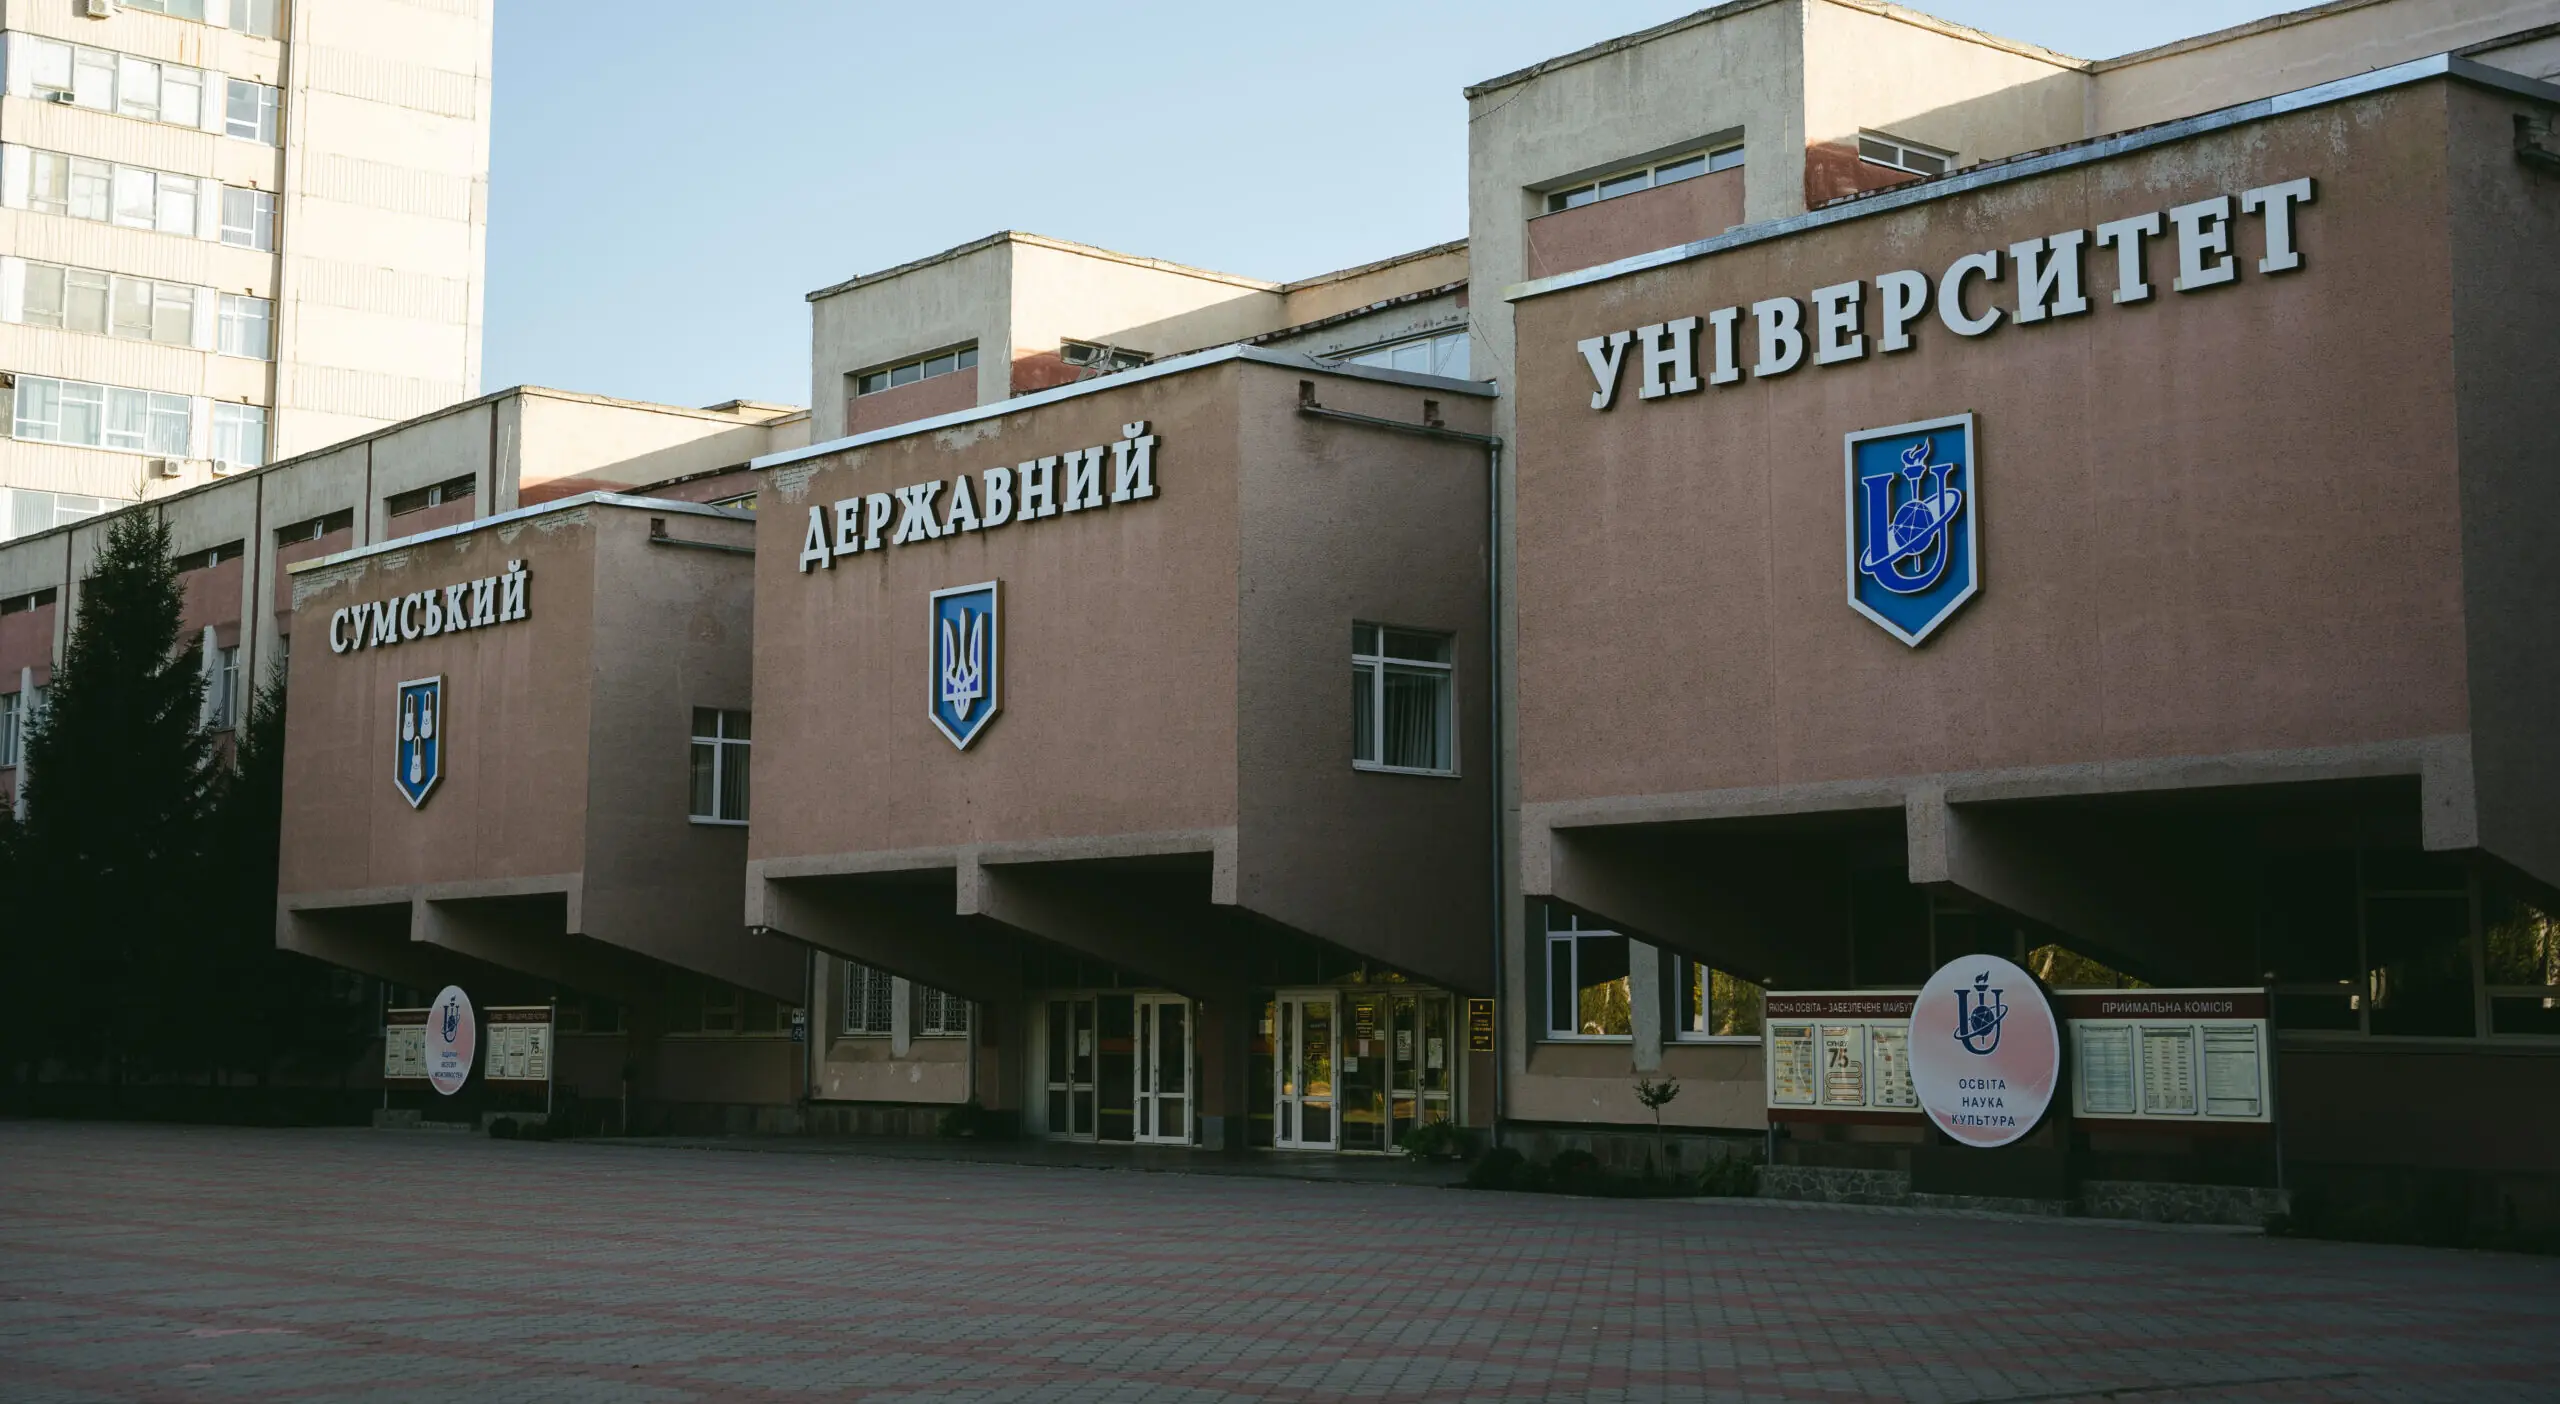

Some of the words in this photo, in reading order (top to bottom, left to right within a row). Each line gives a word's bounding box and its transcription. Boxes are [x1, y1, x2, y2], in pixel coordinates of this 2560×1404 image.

[1577, 176, 2313, 409] УНІВЕРСИТЕТ
[799, 420, 1157, 573] ДЕРЖАВНИЙ
[329, 559, 529, 654] СУМСЬКИЙ
[1768, 1002, 1794, 1013] ЯКІСНА
[1795, 1002, 1821, 1013] ОСВІТА
[1828, 1002, 1881, 1013] ЗАБЕЗПЕЧЕНЕ
[1882, 1001, 1913, 1013] МАЙБУТ
[2102, 1000, 2182, 1014] ПРИЙМАЛЬНА
[2184, 1001, 2233, 1014] КОМІСІЯ
[1828, 1048, 1849, 1068] 75
[1958, 1078, 2006, 1090] ОСВІТА
[1962, 1096, 2004, 1108] НАУКА
[1951, 1114, 2016, 1127] КУЛЬТУРА
